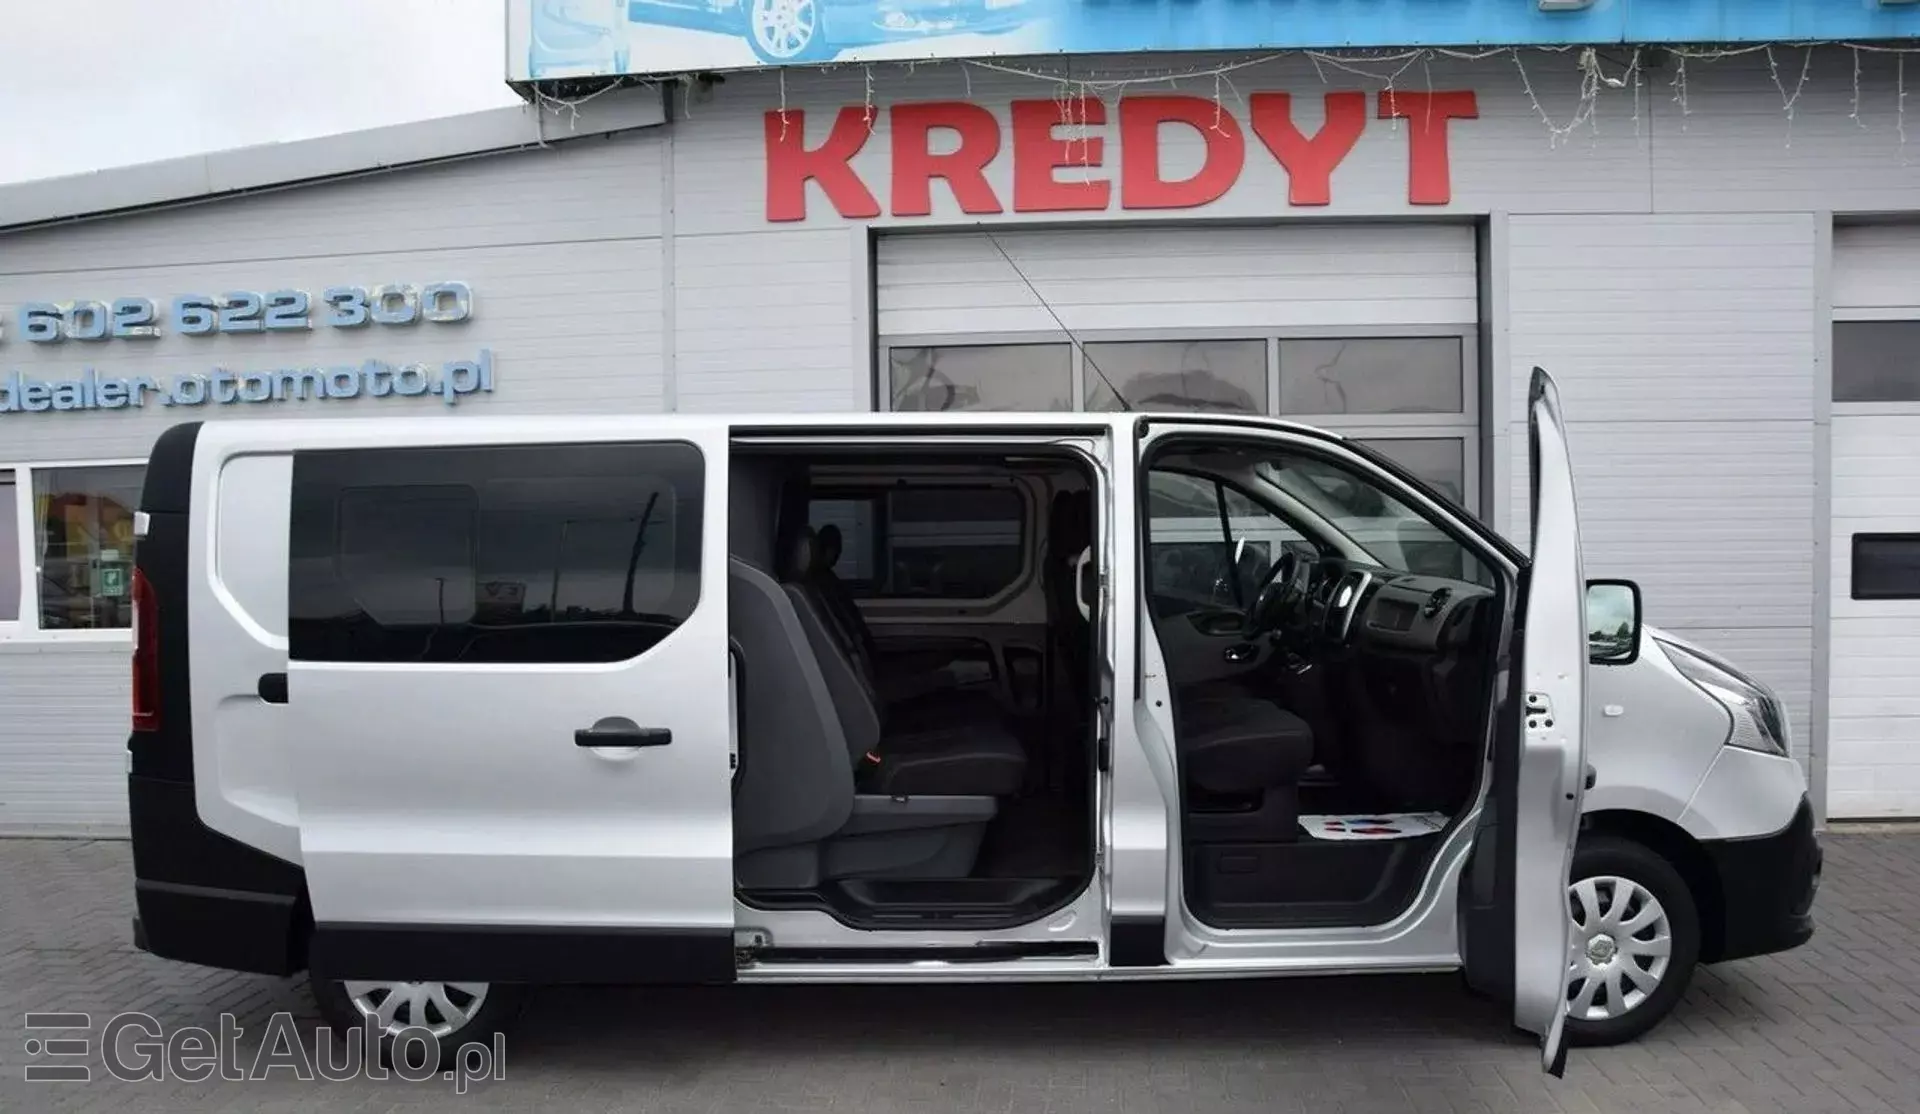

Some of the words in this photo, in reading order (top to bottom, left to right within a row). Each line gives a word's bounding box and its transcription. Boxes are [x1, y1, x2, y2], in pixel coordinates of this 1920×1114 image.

[763, 91, 1478, 222] KREDYT
[20, 297, 159, 342] 602
[174, 290, 312, 335] 622
[323, 281, 473, 328] 300
